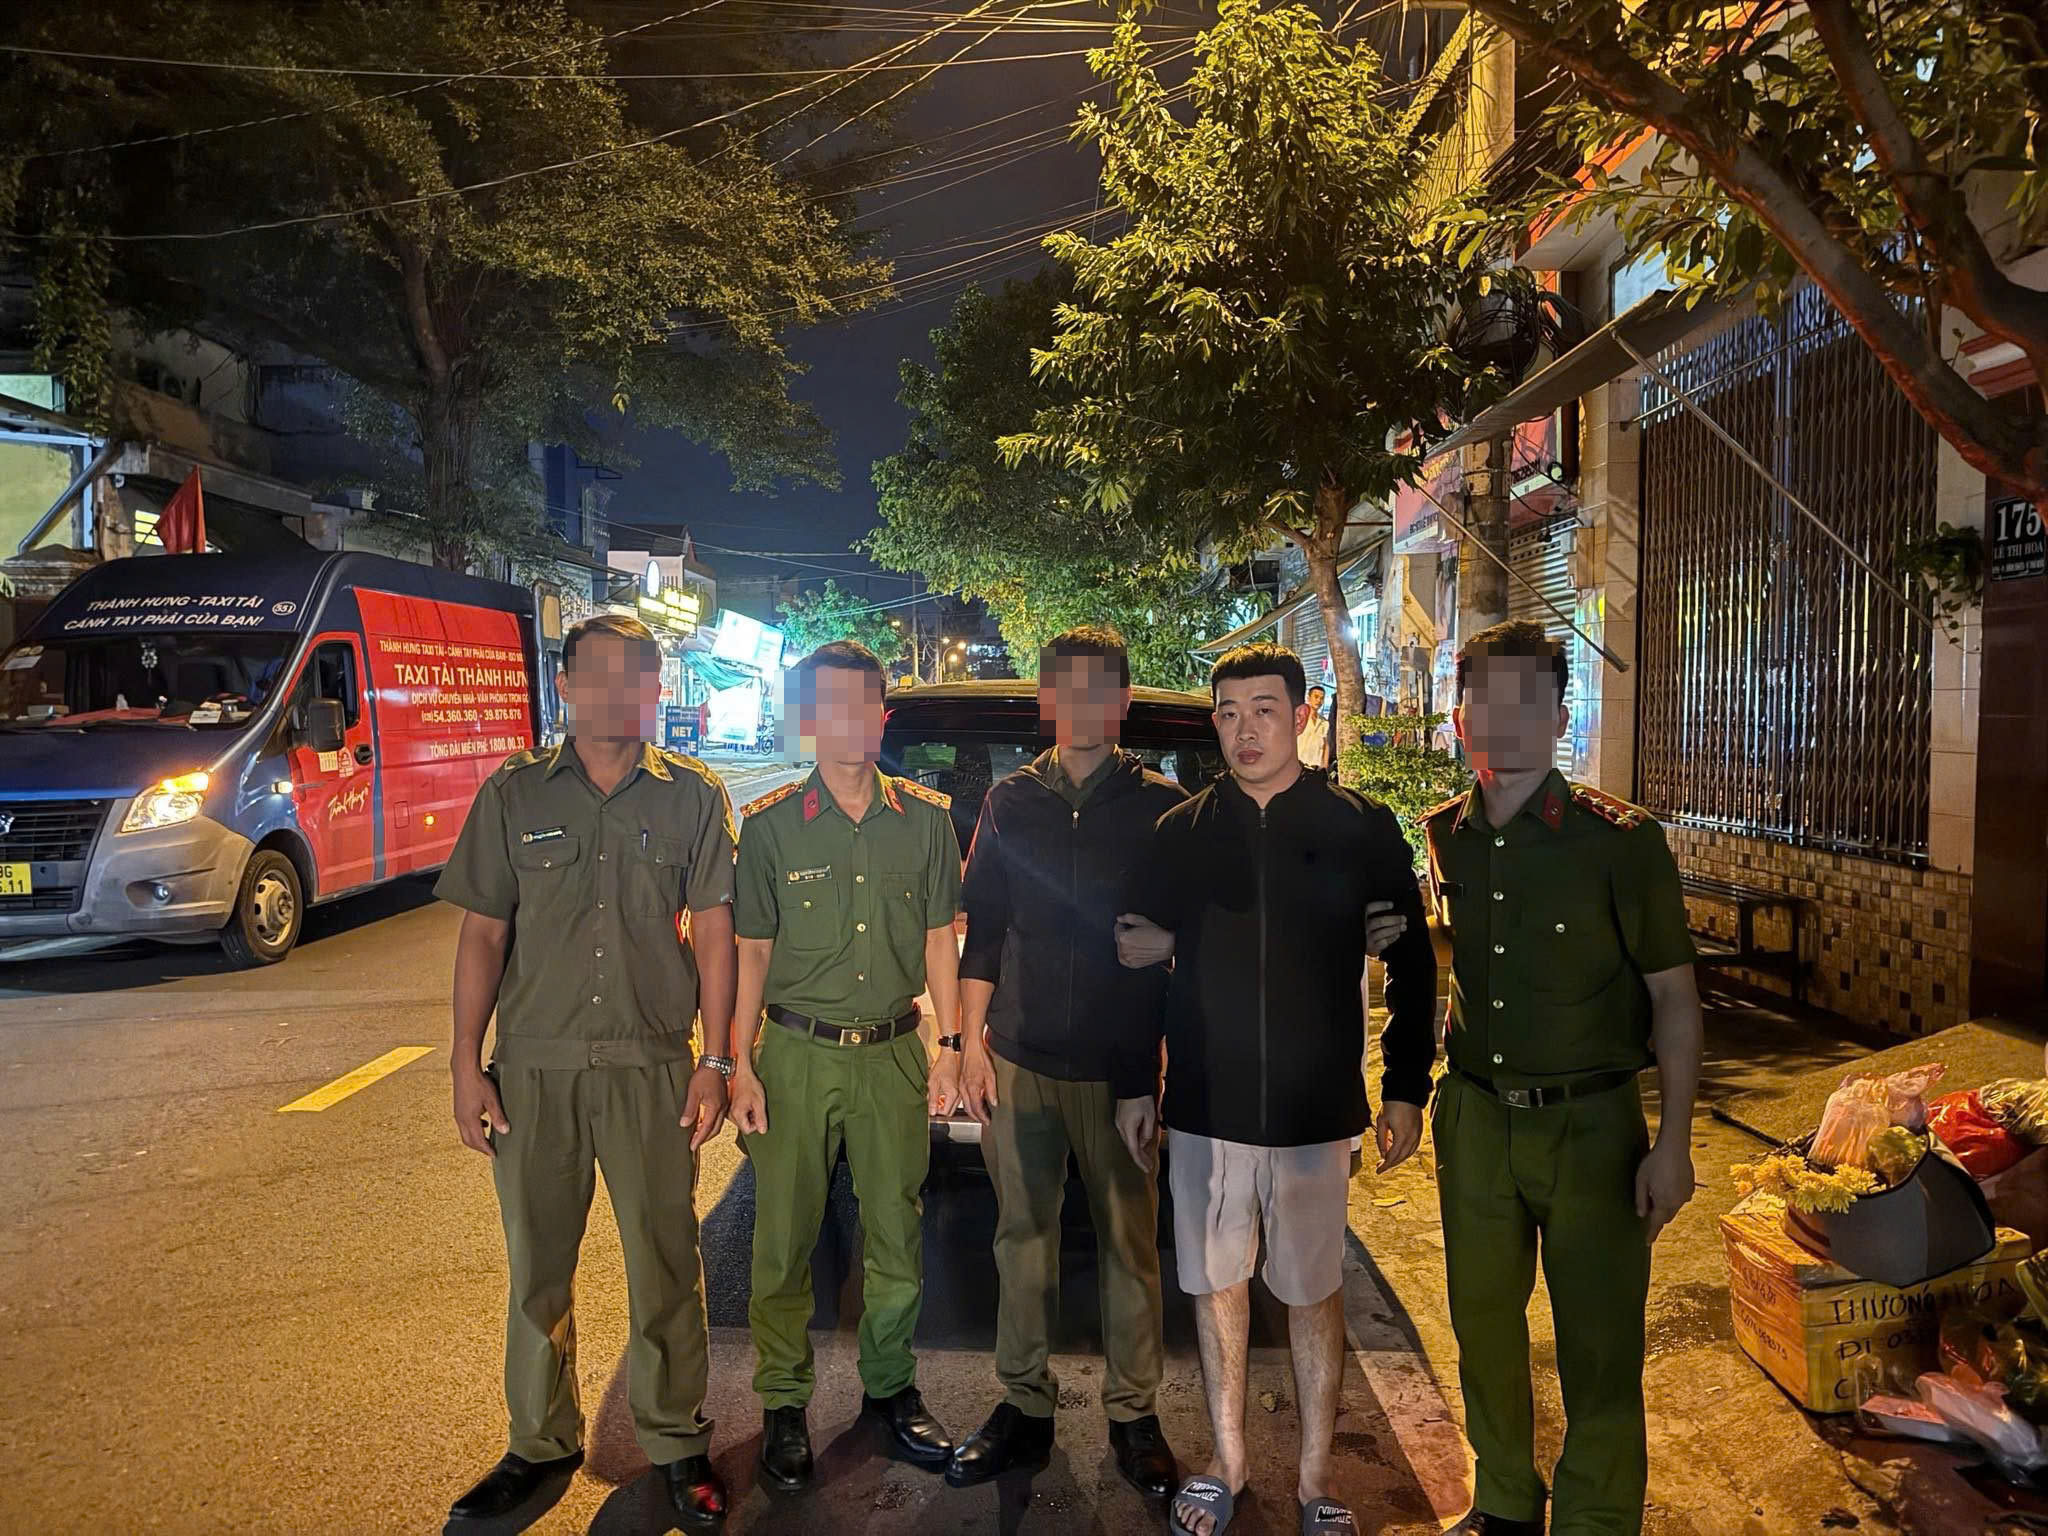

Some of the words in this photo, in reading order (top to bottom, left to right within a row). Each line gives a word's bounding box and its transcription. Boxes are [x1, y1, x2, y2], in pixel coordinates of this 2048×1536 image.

[1997, 502, 2041, 541] 175
[198, 596, 236, 607] TAXI
[111, 615, 143, 626] TAY
[141, 612, 184, 625] PHẢI
[184, 612, 219, 625] CỦA
[394, 663, 429, 686] TAXI
[431, 661, 455, 686] TẢI
[456, 662, 501, 687] THÀNH
[504, 669, 528, 688] HƯN
